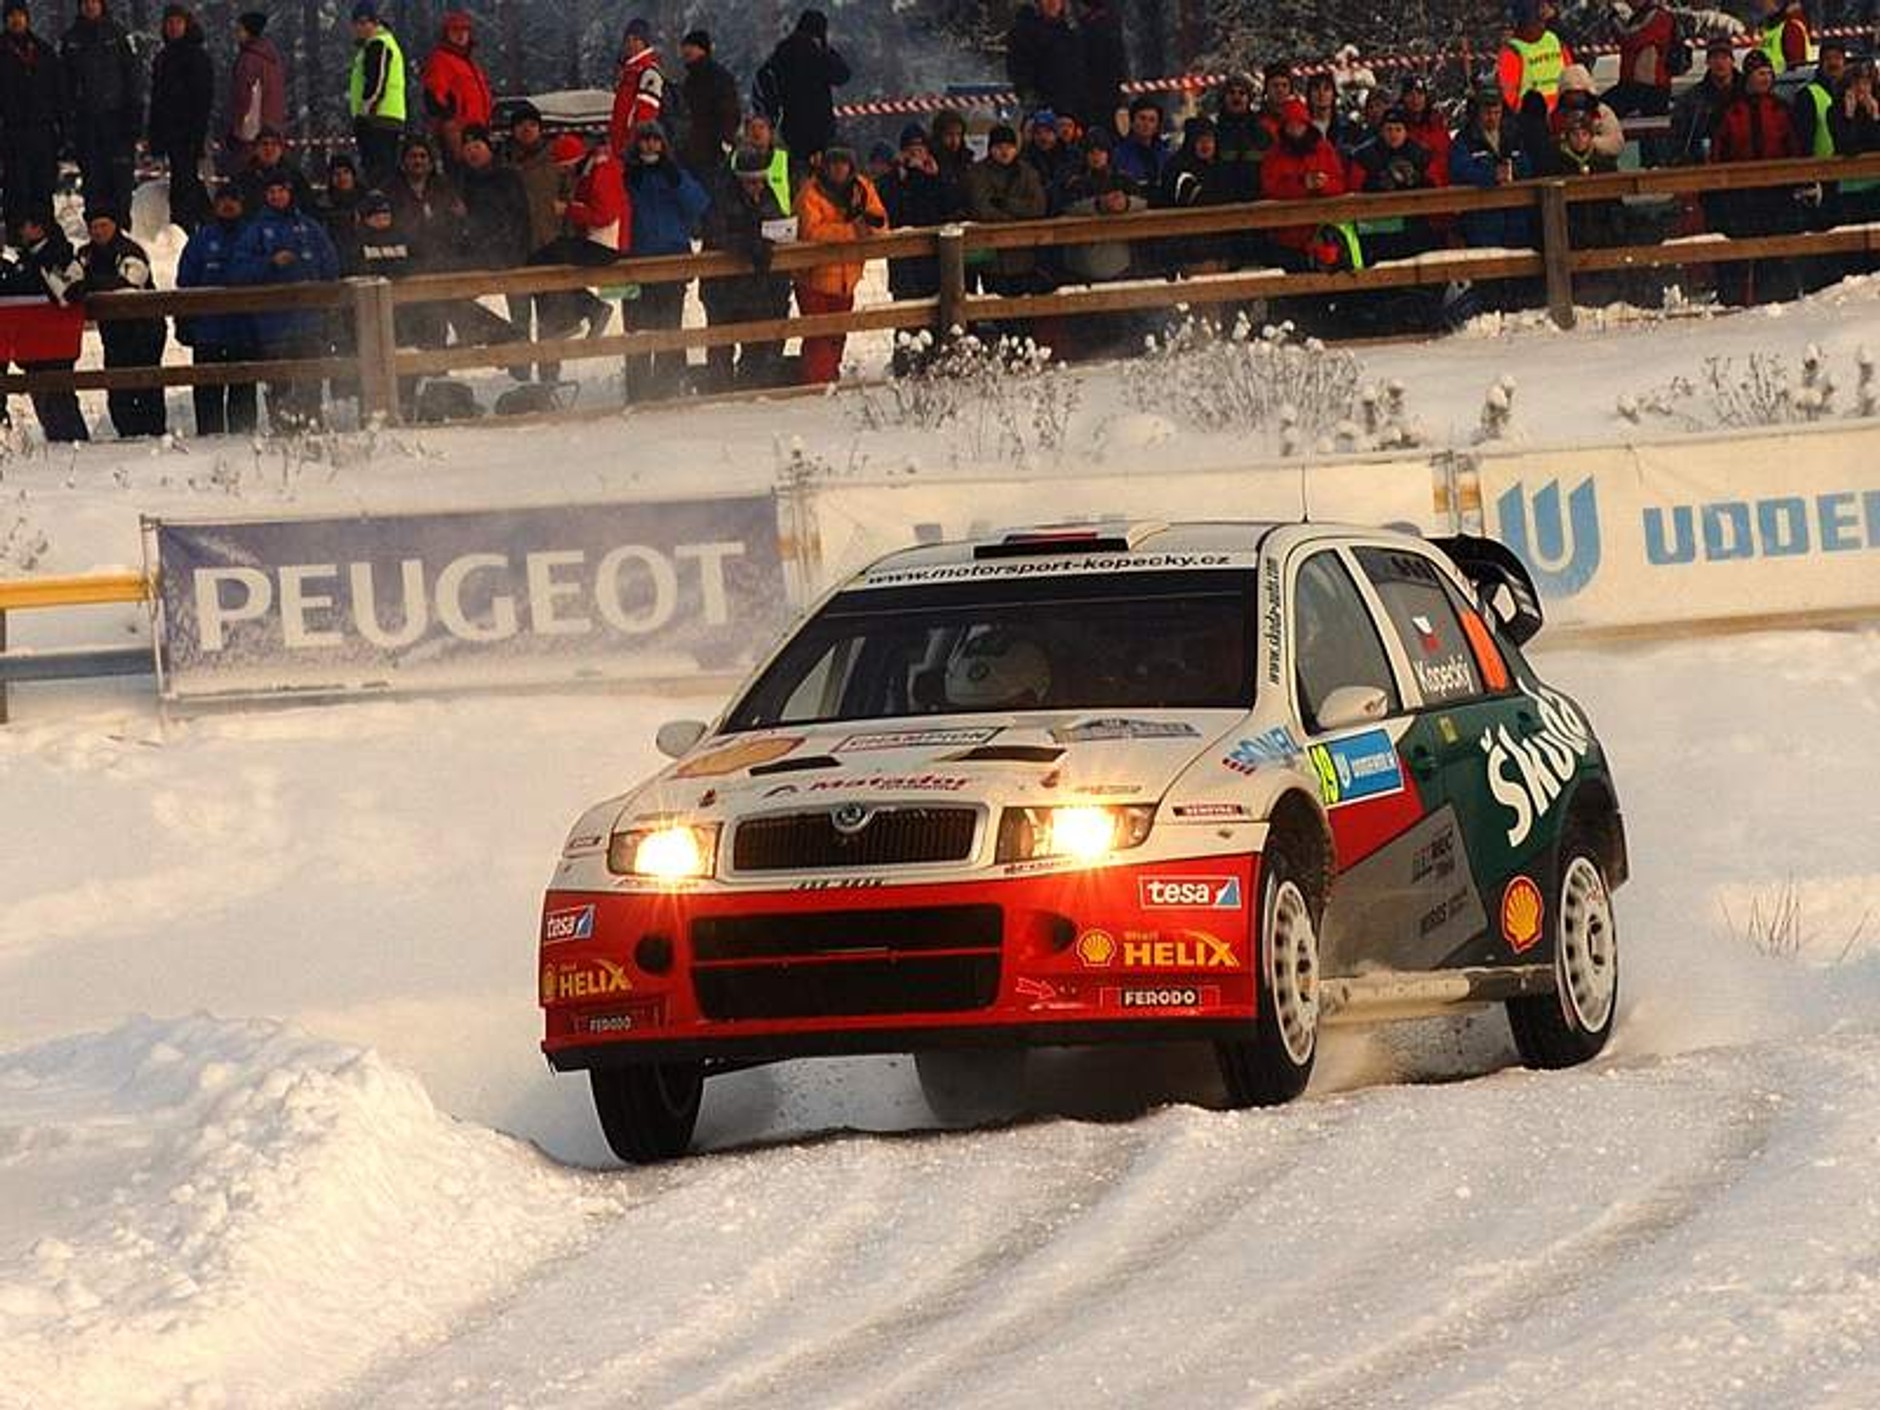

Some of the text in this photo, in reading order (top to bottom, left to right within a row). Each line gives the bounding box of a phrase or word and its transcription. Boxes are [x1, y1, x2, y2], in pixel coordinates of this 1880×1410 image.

[867, 552, 1231, 585] www.motorsport-kopecky.cz
[193, 542, 746, 652] PEUGEOT
[1147, 879, 1209, 904] tesa
[547, 912, 576, 938] tesa
[1123, 929, 1240, 967] HELIX
[559, 959, 632, 999] HELIX
[1125, 990, 1196, 1006] FERODO
